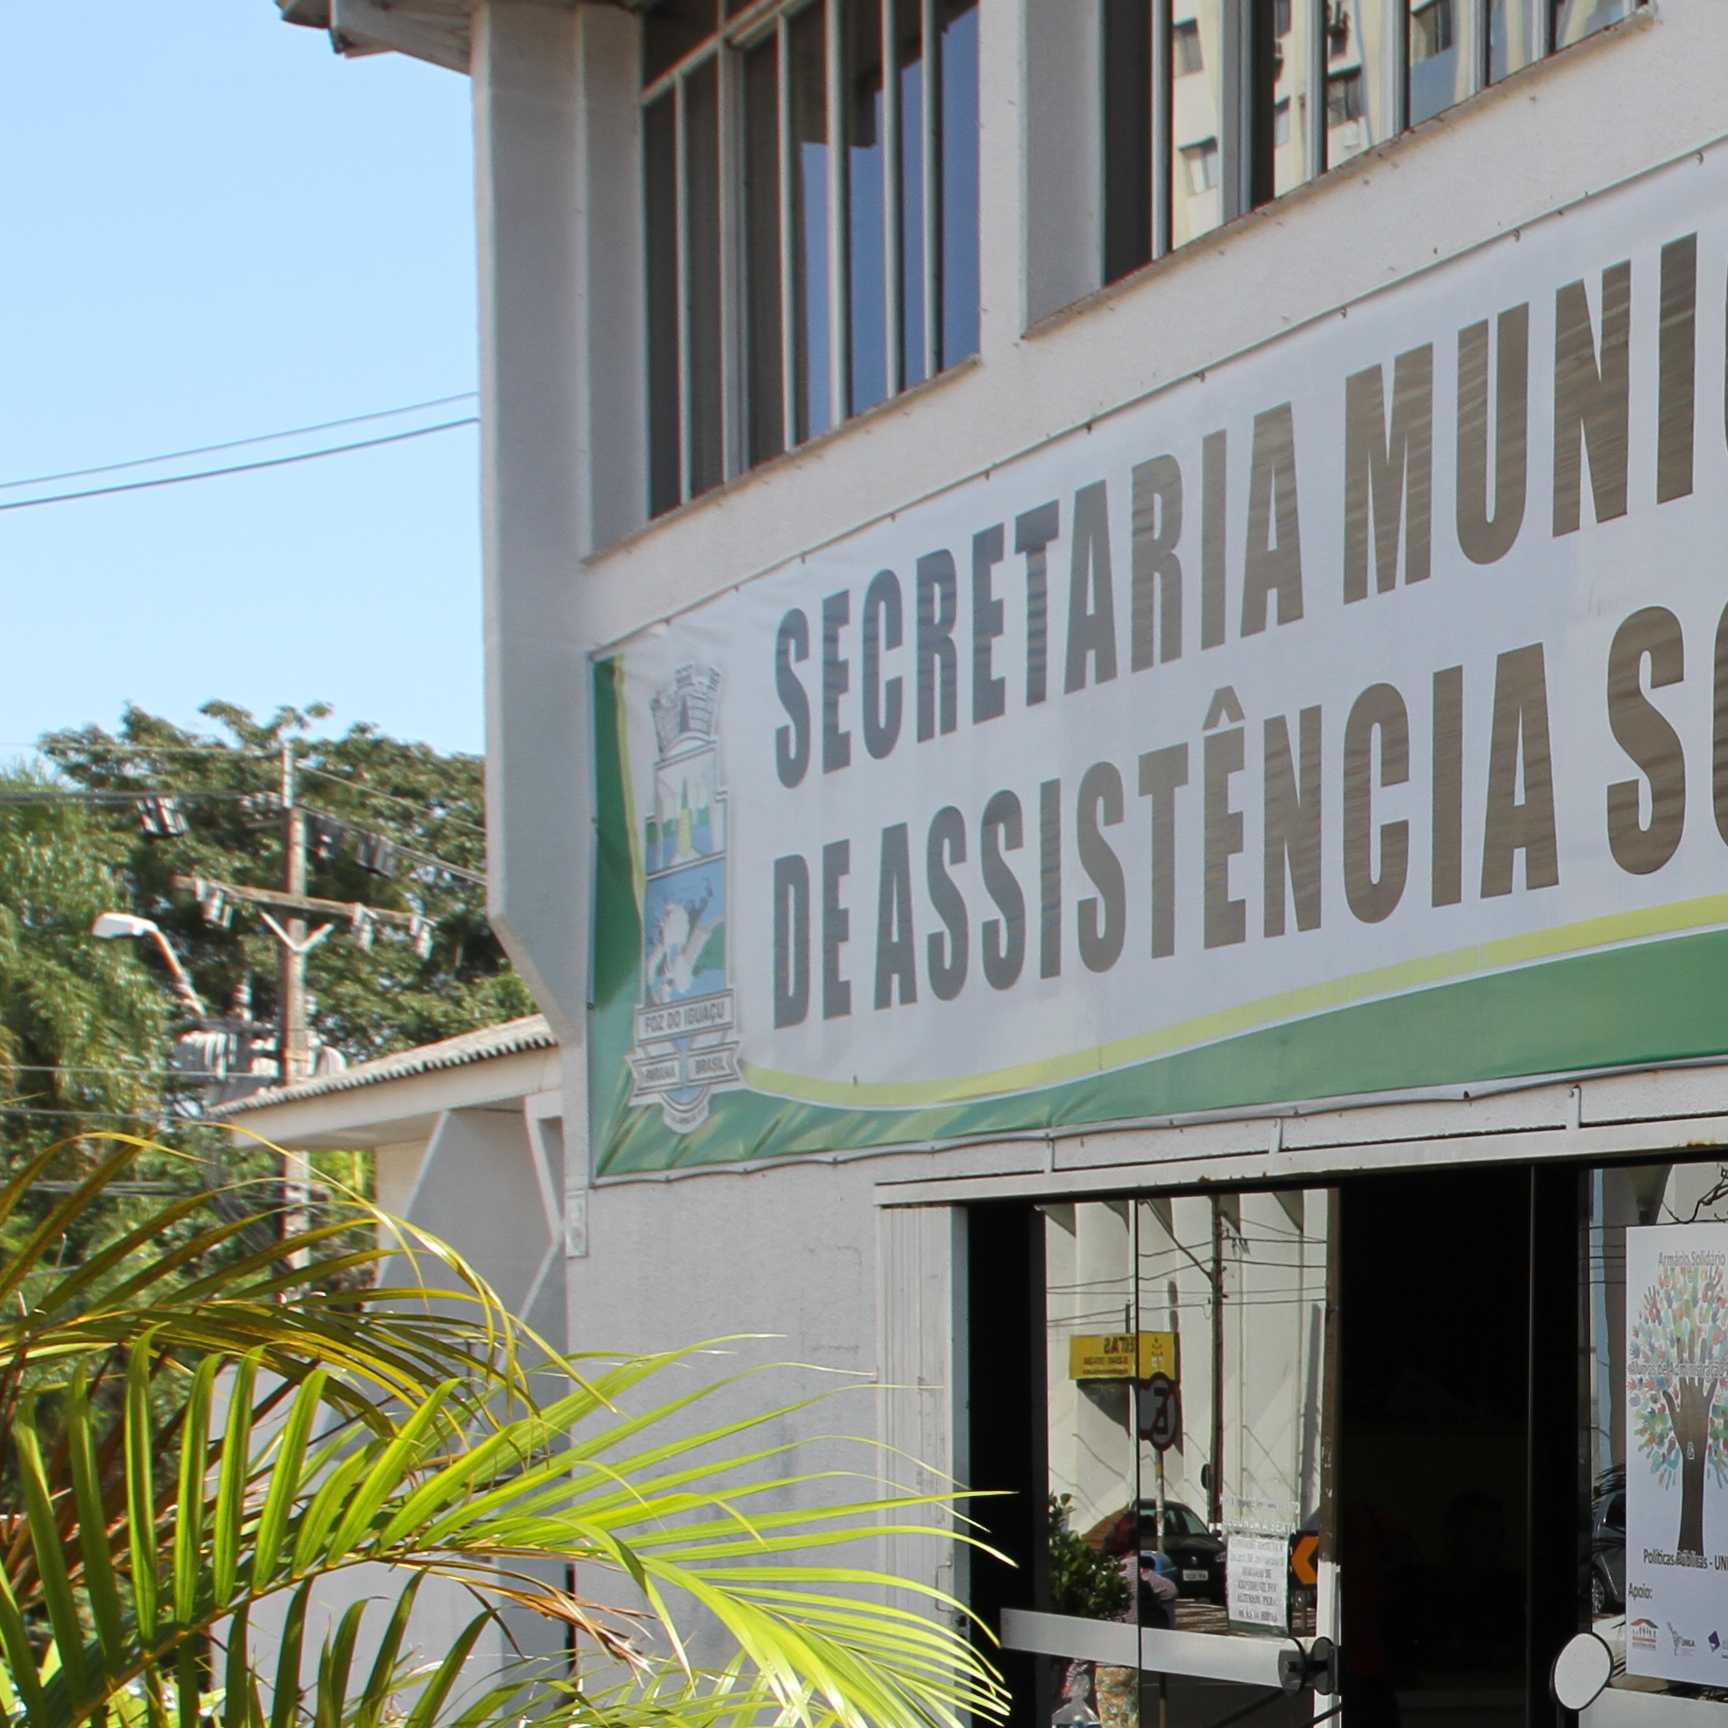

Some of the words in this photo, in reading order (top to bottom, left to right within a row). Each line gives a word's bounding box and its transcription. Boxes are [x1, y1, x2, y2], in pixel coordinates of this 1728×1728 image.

[775, 402, 1304, 789] SECRETARIA
[773, 839, 852, 1031] DE
[873, 642, 1559, 1011] ASSISTÊNCIA
